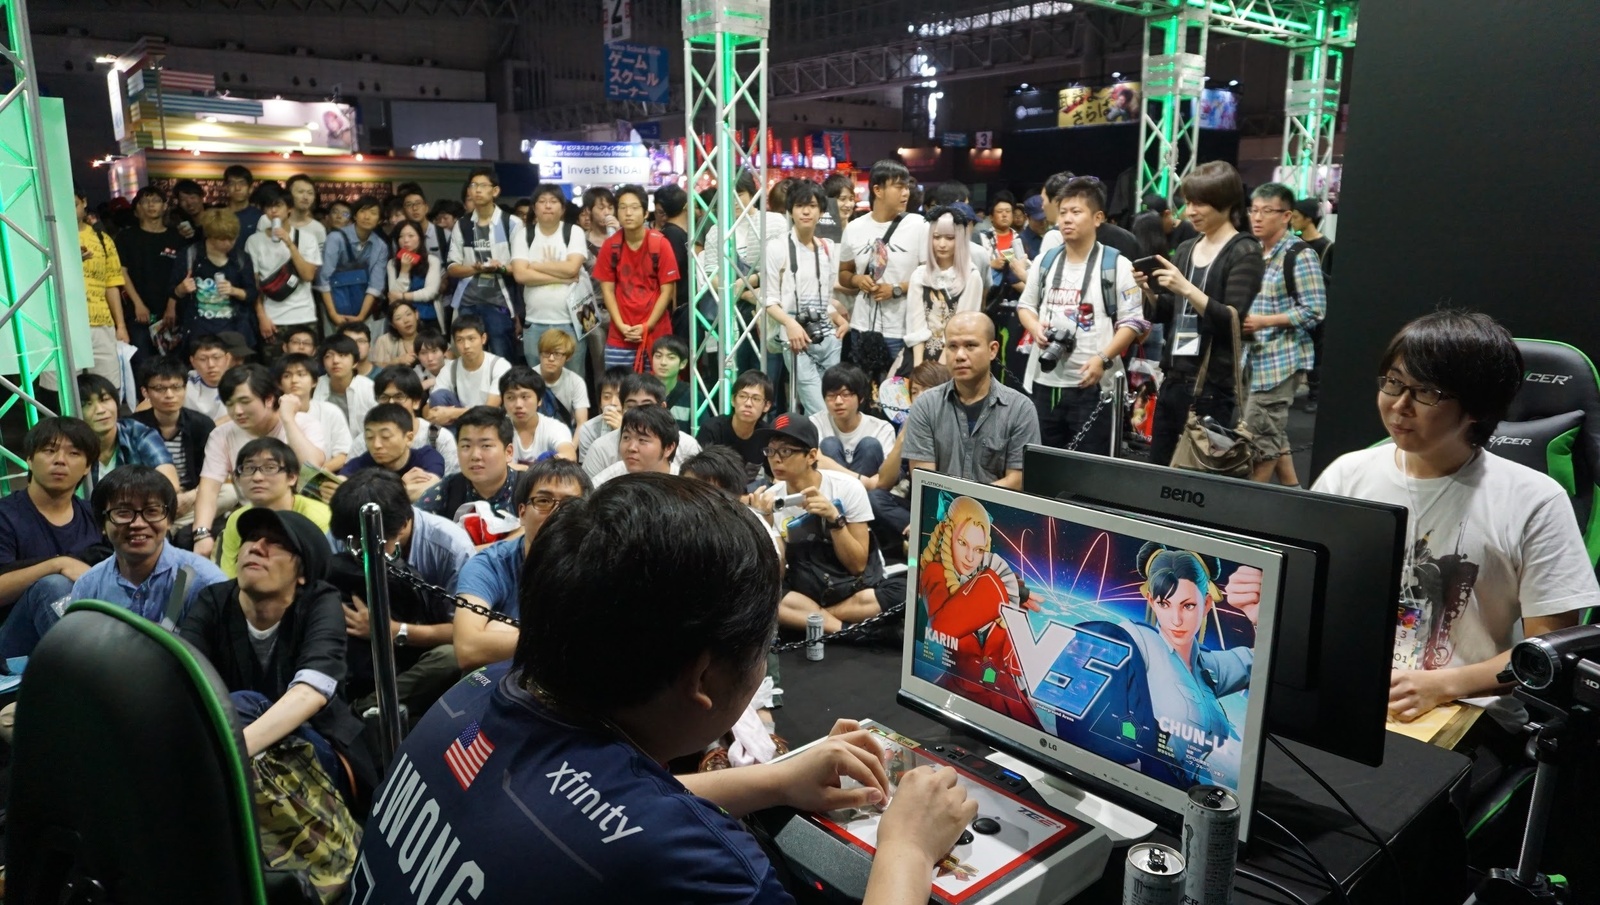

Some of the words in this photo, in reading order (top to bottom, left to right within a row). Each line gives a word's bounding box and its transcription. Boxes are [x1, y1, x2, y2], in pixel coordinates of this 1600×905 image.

[609, 50, 647, 69] ゲーム
[609, 67, 660, 87] スクール
[609, 84, 649, 97] コーナー
[979, 133, 988, 147] 3
[567, 164, 599, 175] Invest
[1160, 485, 1205, 508] BenQ
[924, 626, 959, 651] KARIN
[1048, 743, 1057, 752] LG
[545, 760, 644, 844] xfinity
